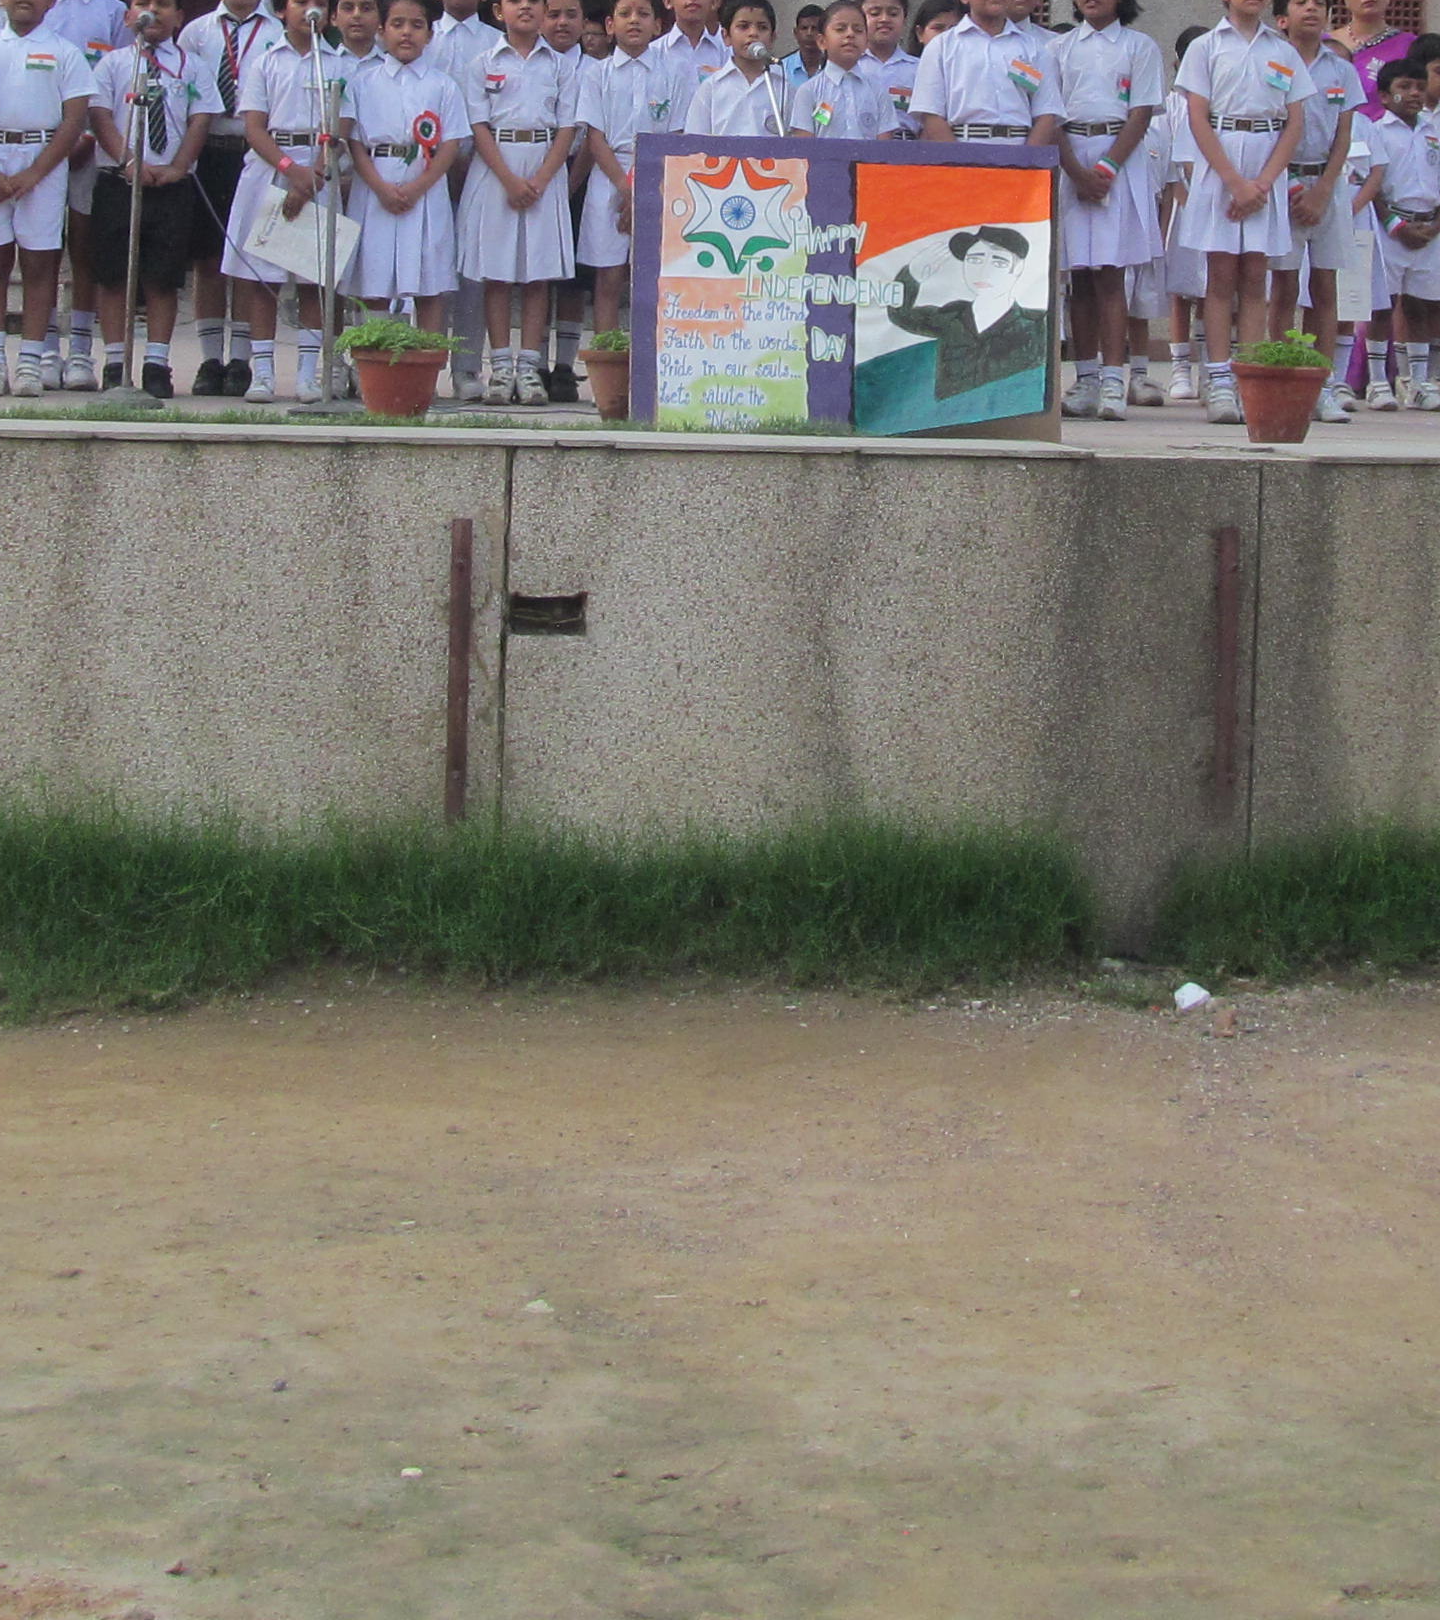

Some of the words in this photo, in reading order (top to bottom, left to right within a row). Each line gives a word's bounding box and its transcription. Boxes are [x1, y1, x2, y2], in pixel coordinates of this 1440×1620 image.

[791, 215, 868, 255] HAPPY
[736, 255, 904, 308] INDEPENDENCE
[663, 292, 719, 320] Freedom
[724, 303, 736, 321] in
[741, 300, 762, 321] the
[663, 327, 705, 350] Faith
[713, 333, 726, 350] in
[731, 330, 752, 352] the
[811, 326, 847, 362] DAY
[659, 353, 694, 377] Pride
[702, 360, 718, 377] in
[725, 363, 747, 377] our
[702, 384, 745, 406] salute
[748, 384, 766, 406] the
